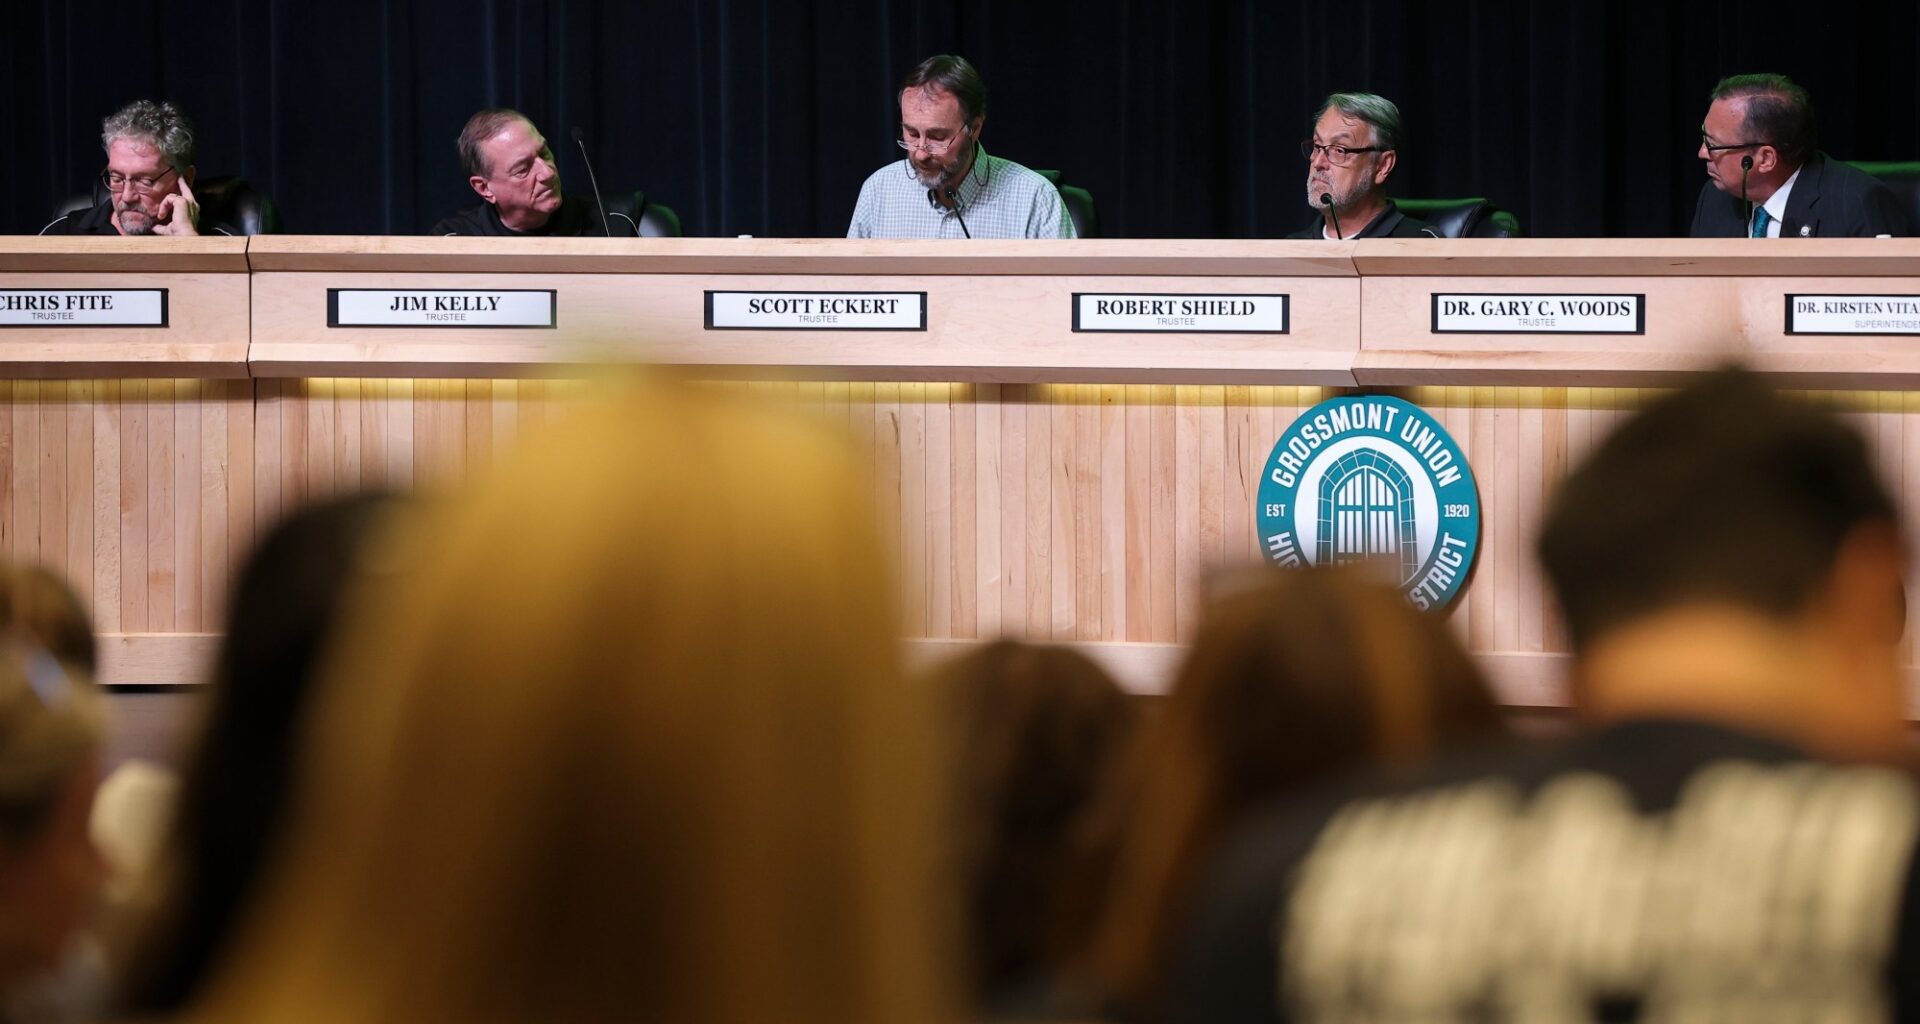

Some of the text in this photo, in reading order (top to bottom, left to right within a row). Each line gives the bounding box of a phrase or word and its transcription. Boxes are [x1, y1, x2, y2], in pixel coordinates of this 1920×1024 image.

[65, 295, 113, 310] FITE
[390, 296, 501, 311] JIM KELLY
[749, 298, 899, 314] SCOTT ECKERT
[1096, 300, 1255, 315] ROBERT SHIELD
[1443, 301, 1630, 316] DR. GARY C. WOODS
[1798, 302, 1920, 314] DR. KIRSTEN VITA
[32, 312, 74, 320] TRUSTEE
[798, 315, 838, 323] TRUSTEE
[1156, 317, 1195, 325] TRUSTEE
[1518, 318, 1556, 326] TRUSTEE
[1855, 319, 1920, 329] SUPERINTENDE
[1271, 403, 1462, 488] GROSSMONT UNION
[1266, 504, 1286, 517] EST
[1444, 504, 1470, 518] 1920
[1267, 531, 1467, 612] HIG STRICT
